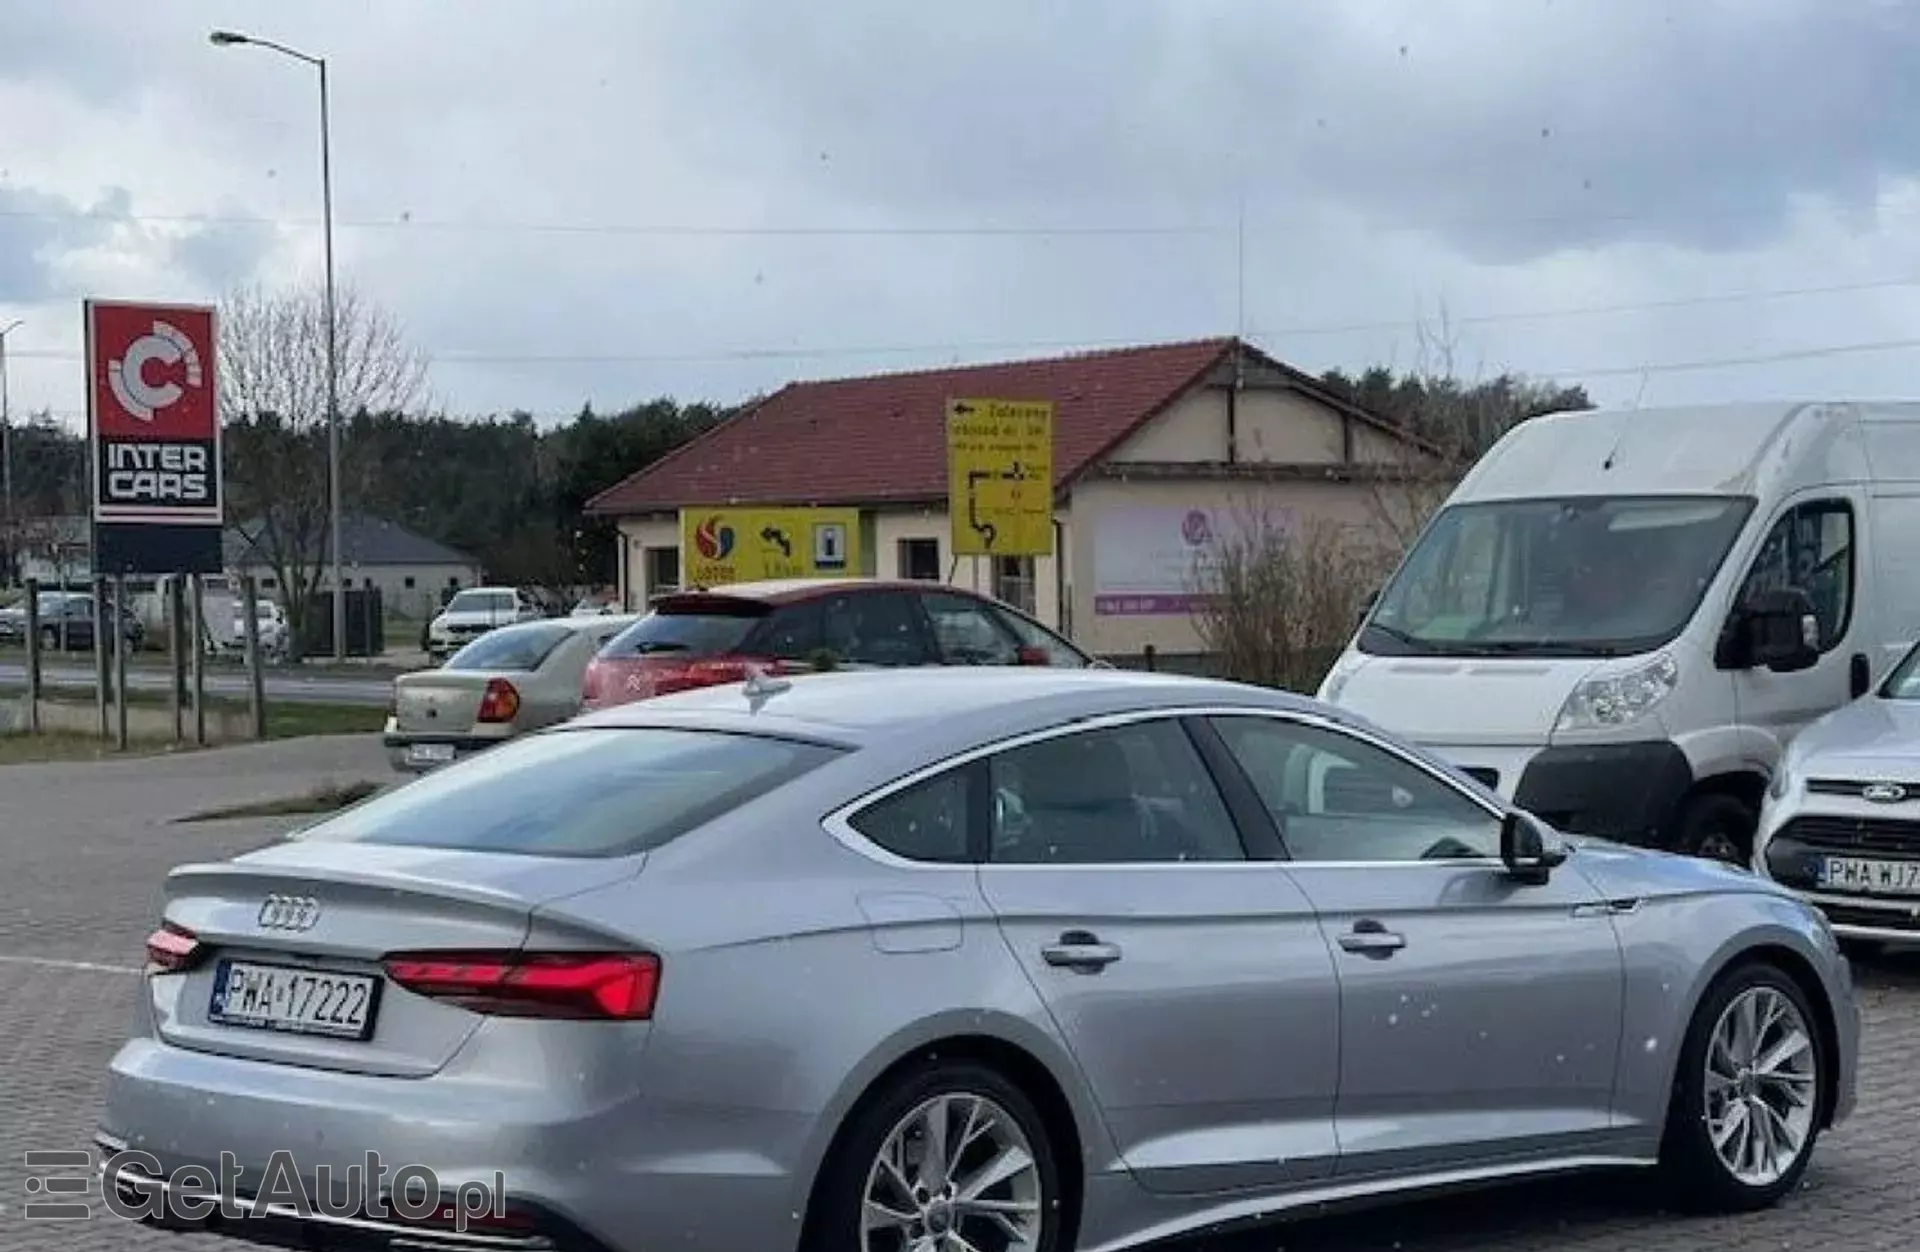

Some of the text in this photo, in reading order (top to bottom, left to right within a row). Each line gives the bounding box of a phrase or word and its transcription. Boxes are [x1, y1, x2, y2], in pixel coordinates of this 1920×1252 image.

[108, 443, 206, 471] INTER
[108, 471, 208, 499] CARS
[1830, 860, 1872, 882] PWA
[230, 968, 367, 1025] PWA 17222
